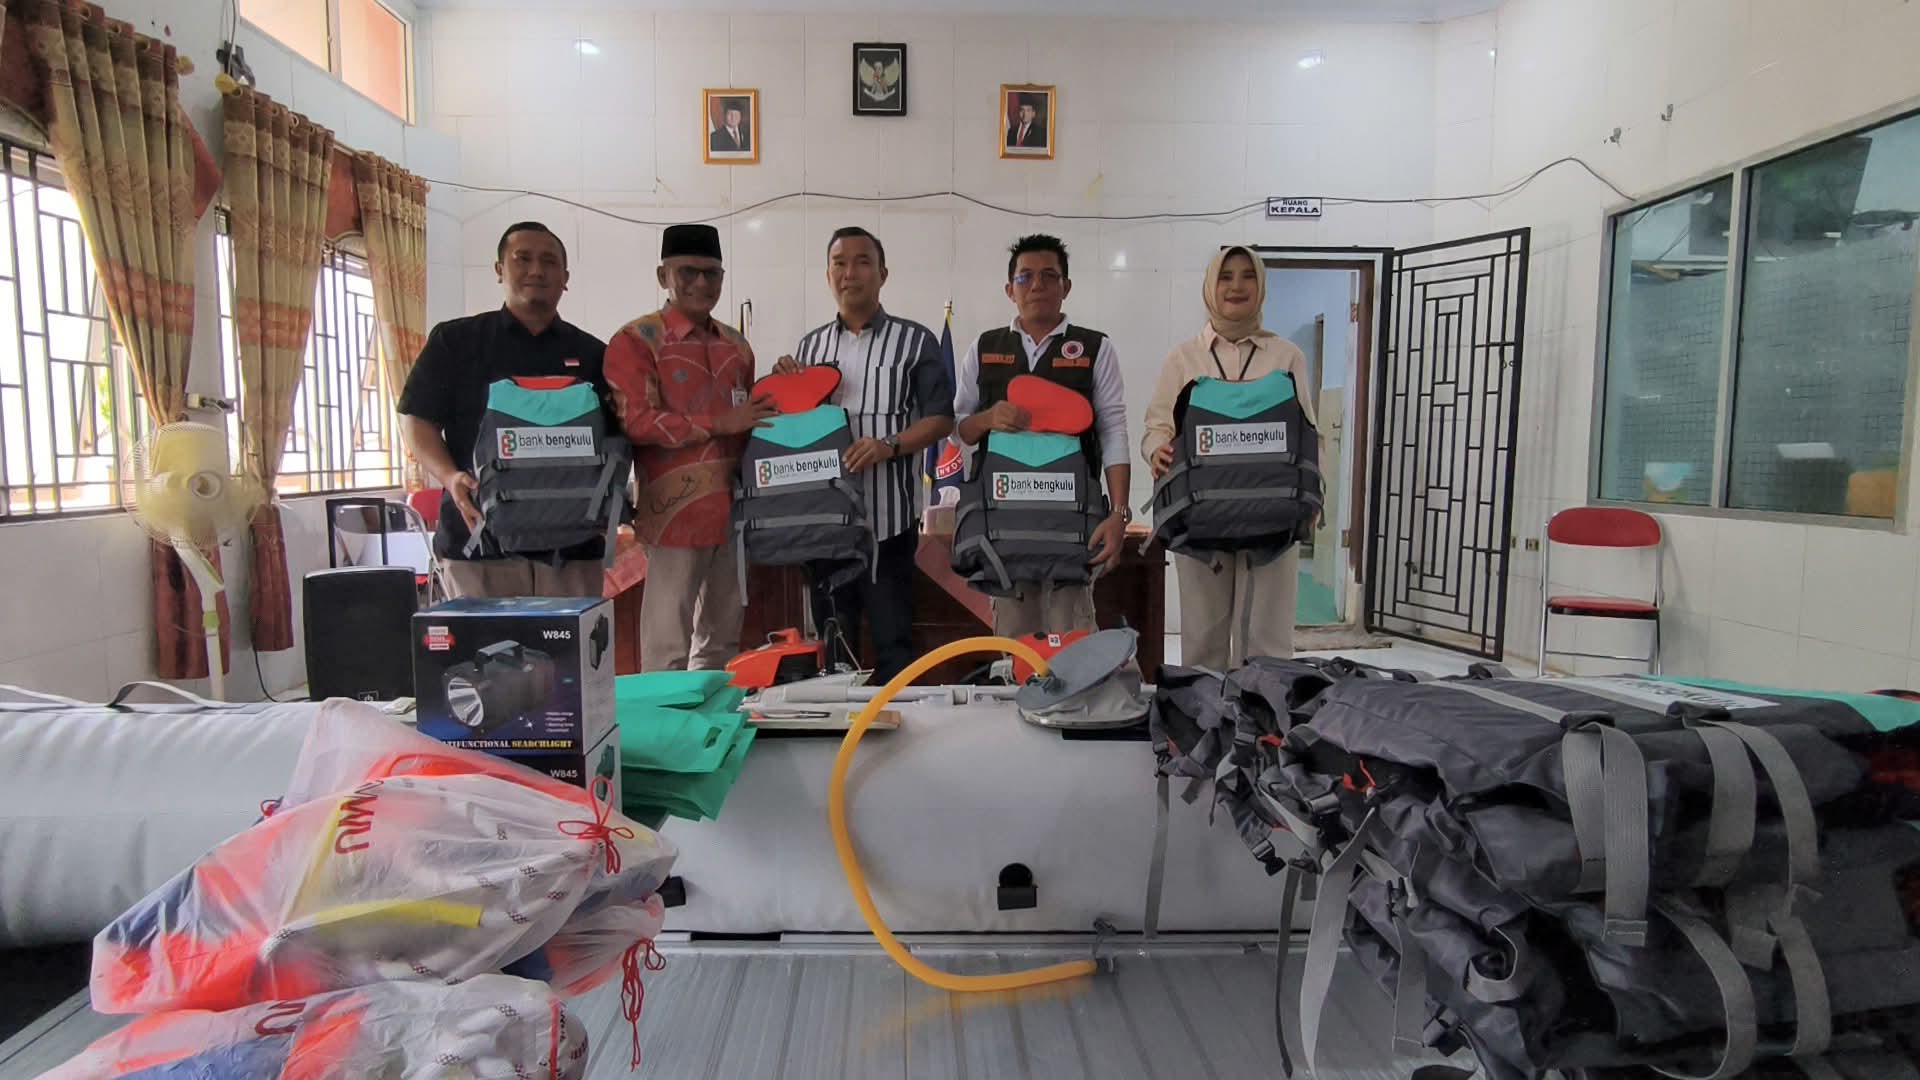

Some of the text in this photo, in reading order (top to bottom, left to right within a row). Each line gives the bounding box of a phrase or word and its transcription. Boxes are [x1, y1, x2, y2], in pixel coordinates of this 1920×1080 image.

[1270, 206, 1320, 214] KEPALA
[519, 433, 592, 449] bank bengkulu
[1215, 428, 1285, 445] bank bengkulu
[773, 456, 838, 475] bank bengkulu
[1010, 477, 1074, 493] bank bengkulu
[542, 630, 572, 640] W845
[511, 739, 574, 749] SEARCHLIGHT
[550, 768, 578, 779] W845
